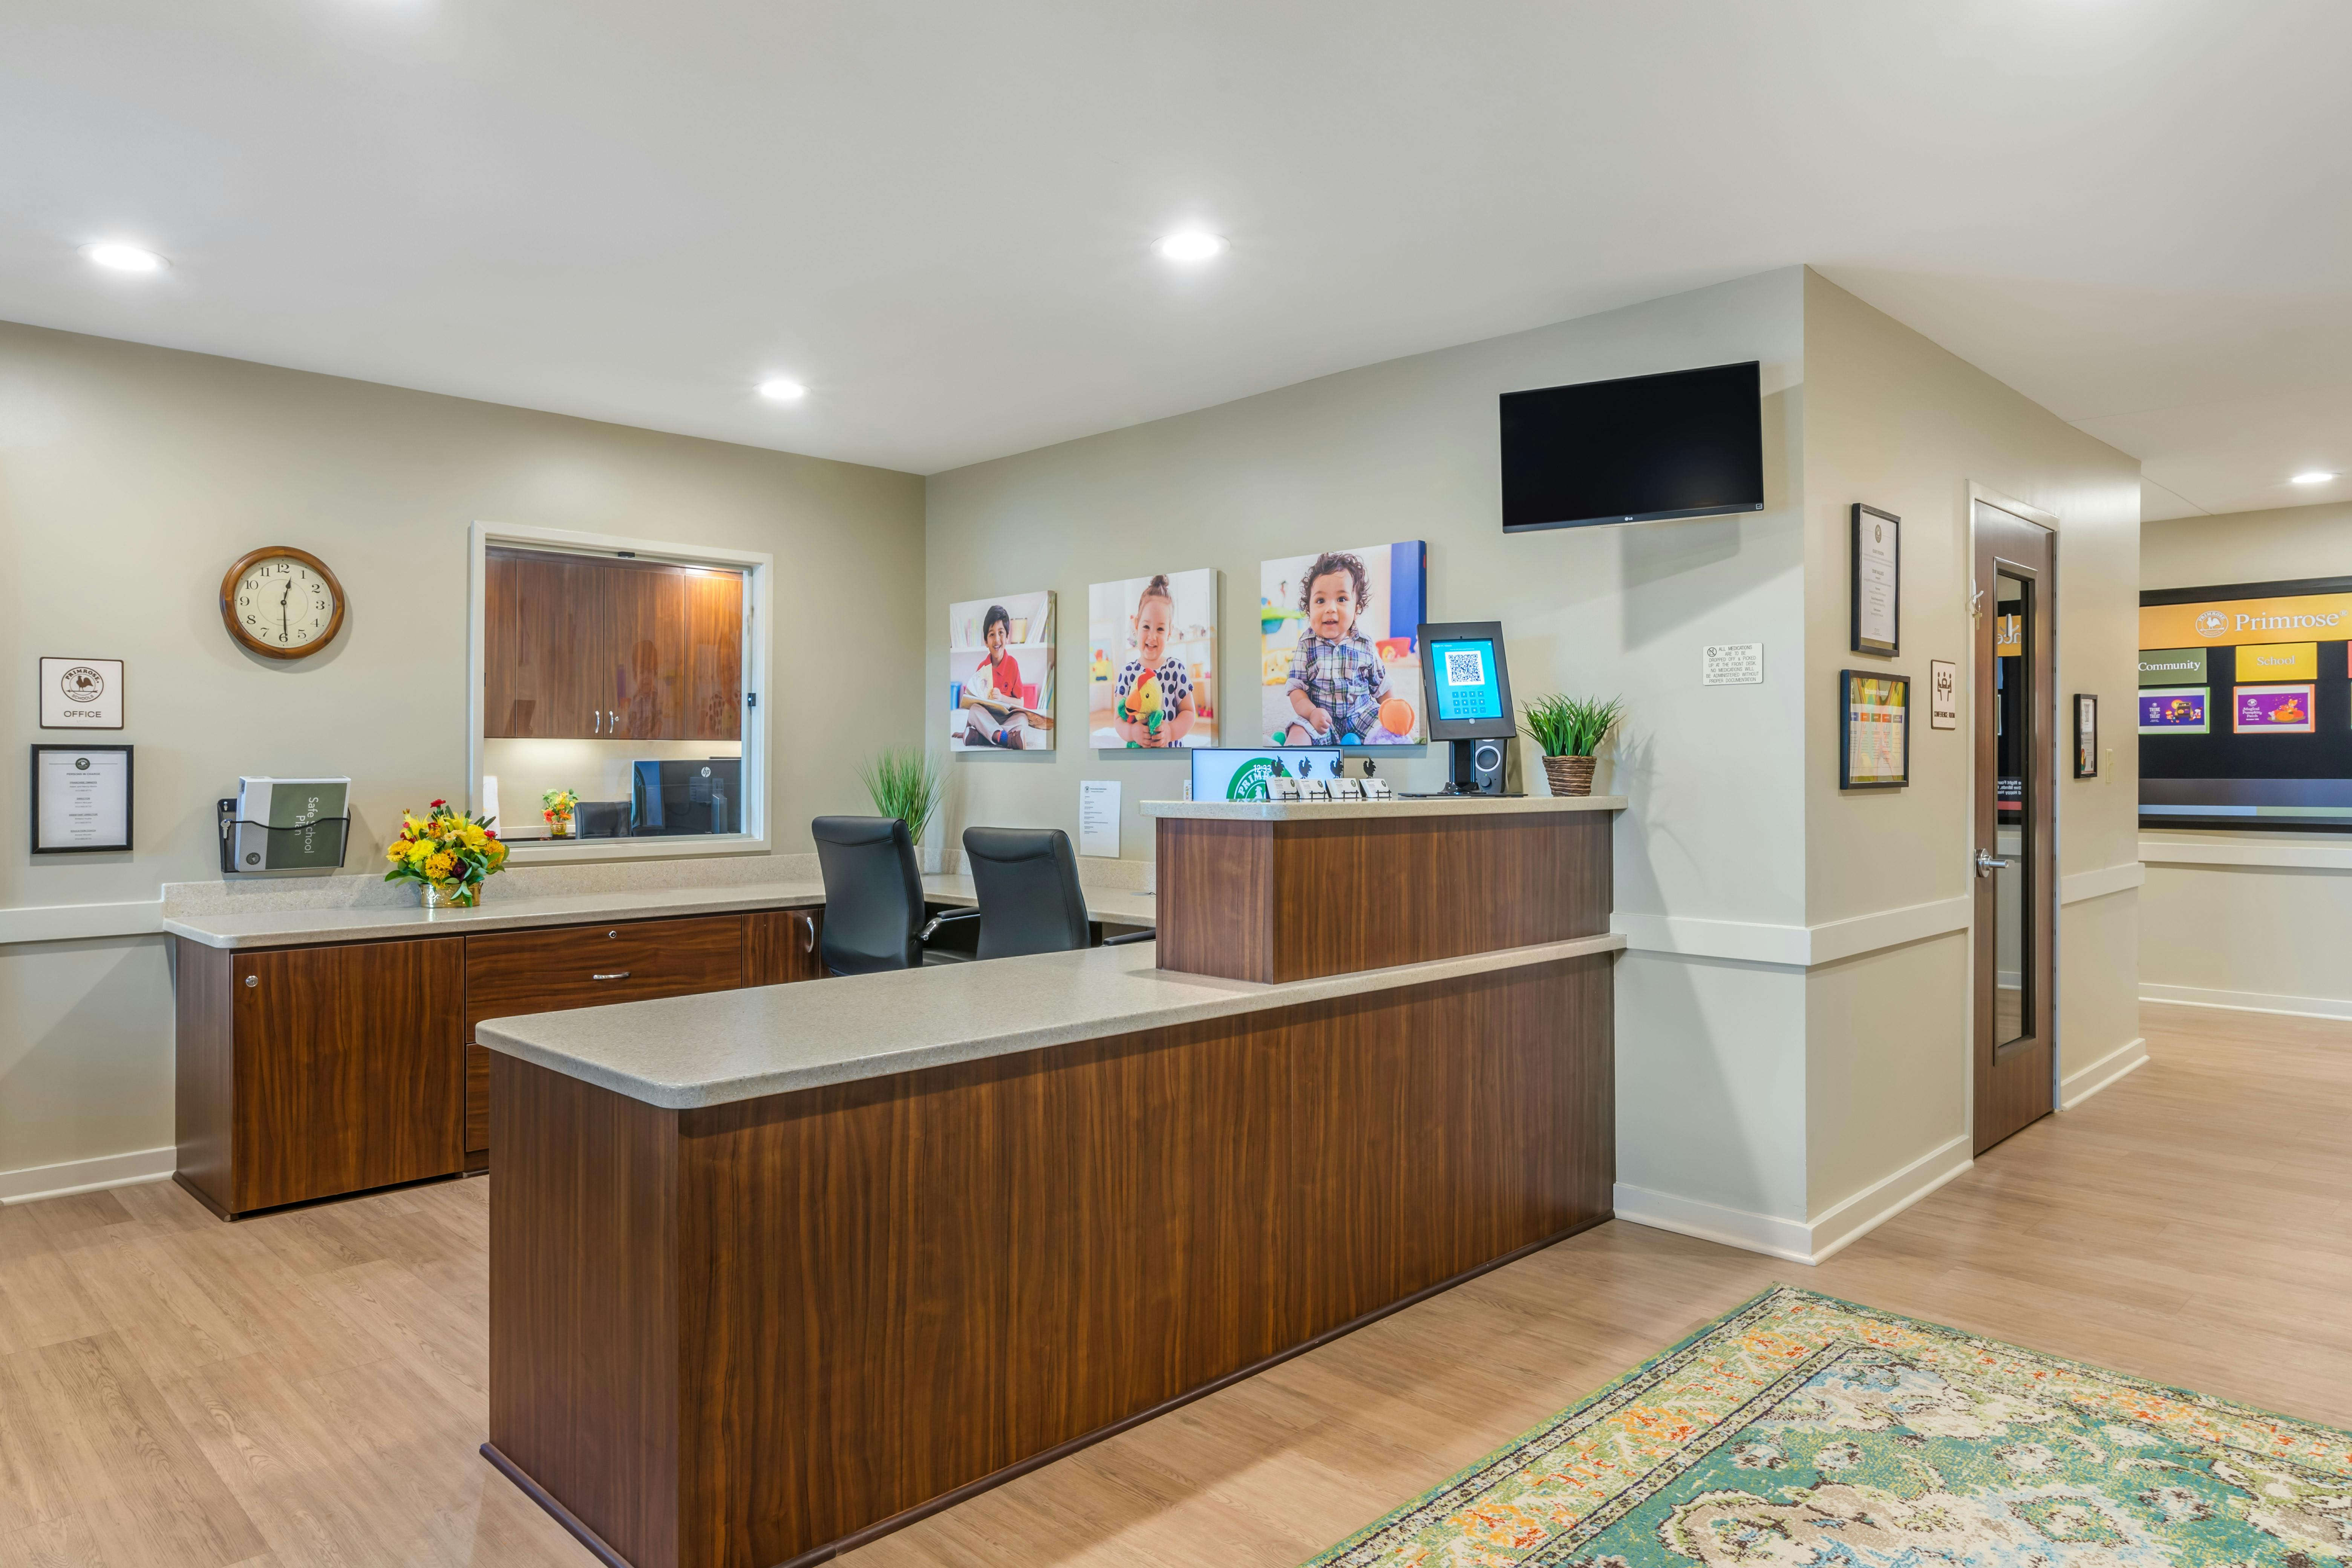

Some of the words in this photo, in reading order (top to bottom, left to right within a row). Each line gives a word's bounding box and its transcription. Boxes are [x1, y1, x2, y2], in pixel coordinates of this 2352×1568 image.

[260, 567, 271, 577] 11
[276, 564, 290, 573] 12
[301, 570, 306, 579] 1
[245, 580, 259, 590] 10
[311, 584, 320, 593] 2
[240, 596, 250, 606] 9
[315, 600, 325, 609] 3
[247, 615, 256, 624] 8
[2198, 612, 2226, 621] PRIMROSE
[310, 618, 320, 627] 4
[260, 628, 270, 637] 7
[279, 632, 288, 642] 6
[298, 629, 306, 639] 5
[2138, 660, 2200, 671] Community
[2257, 655, 2295, 666] School
[65, 669, 100, 681] PRIMROSE
[702, 767, 710, 777] hp
[1253, 764, 1271, 773] 12:33
[307, 797, 318, 818] Safe
[294, 816, 306, 836] Plan
